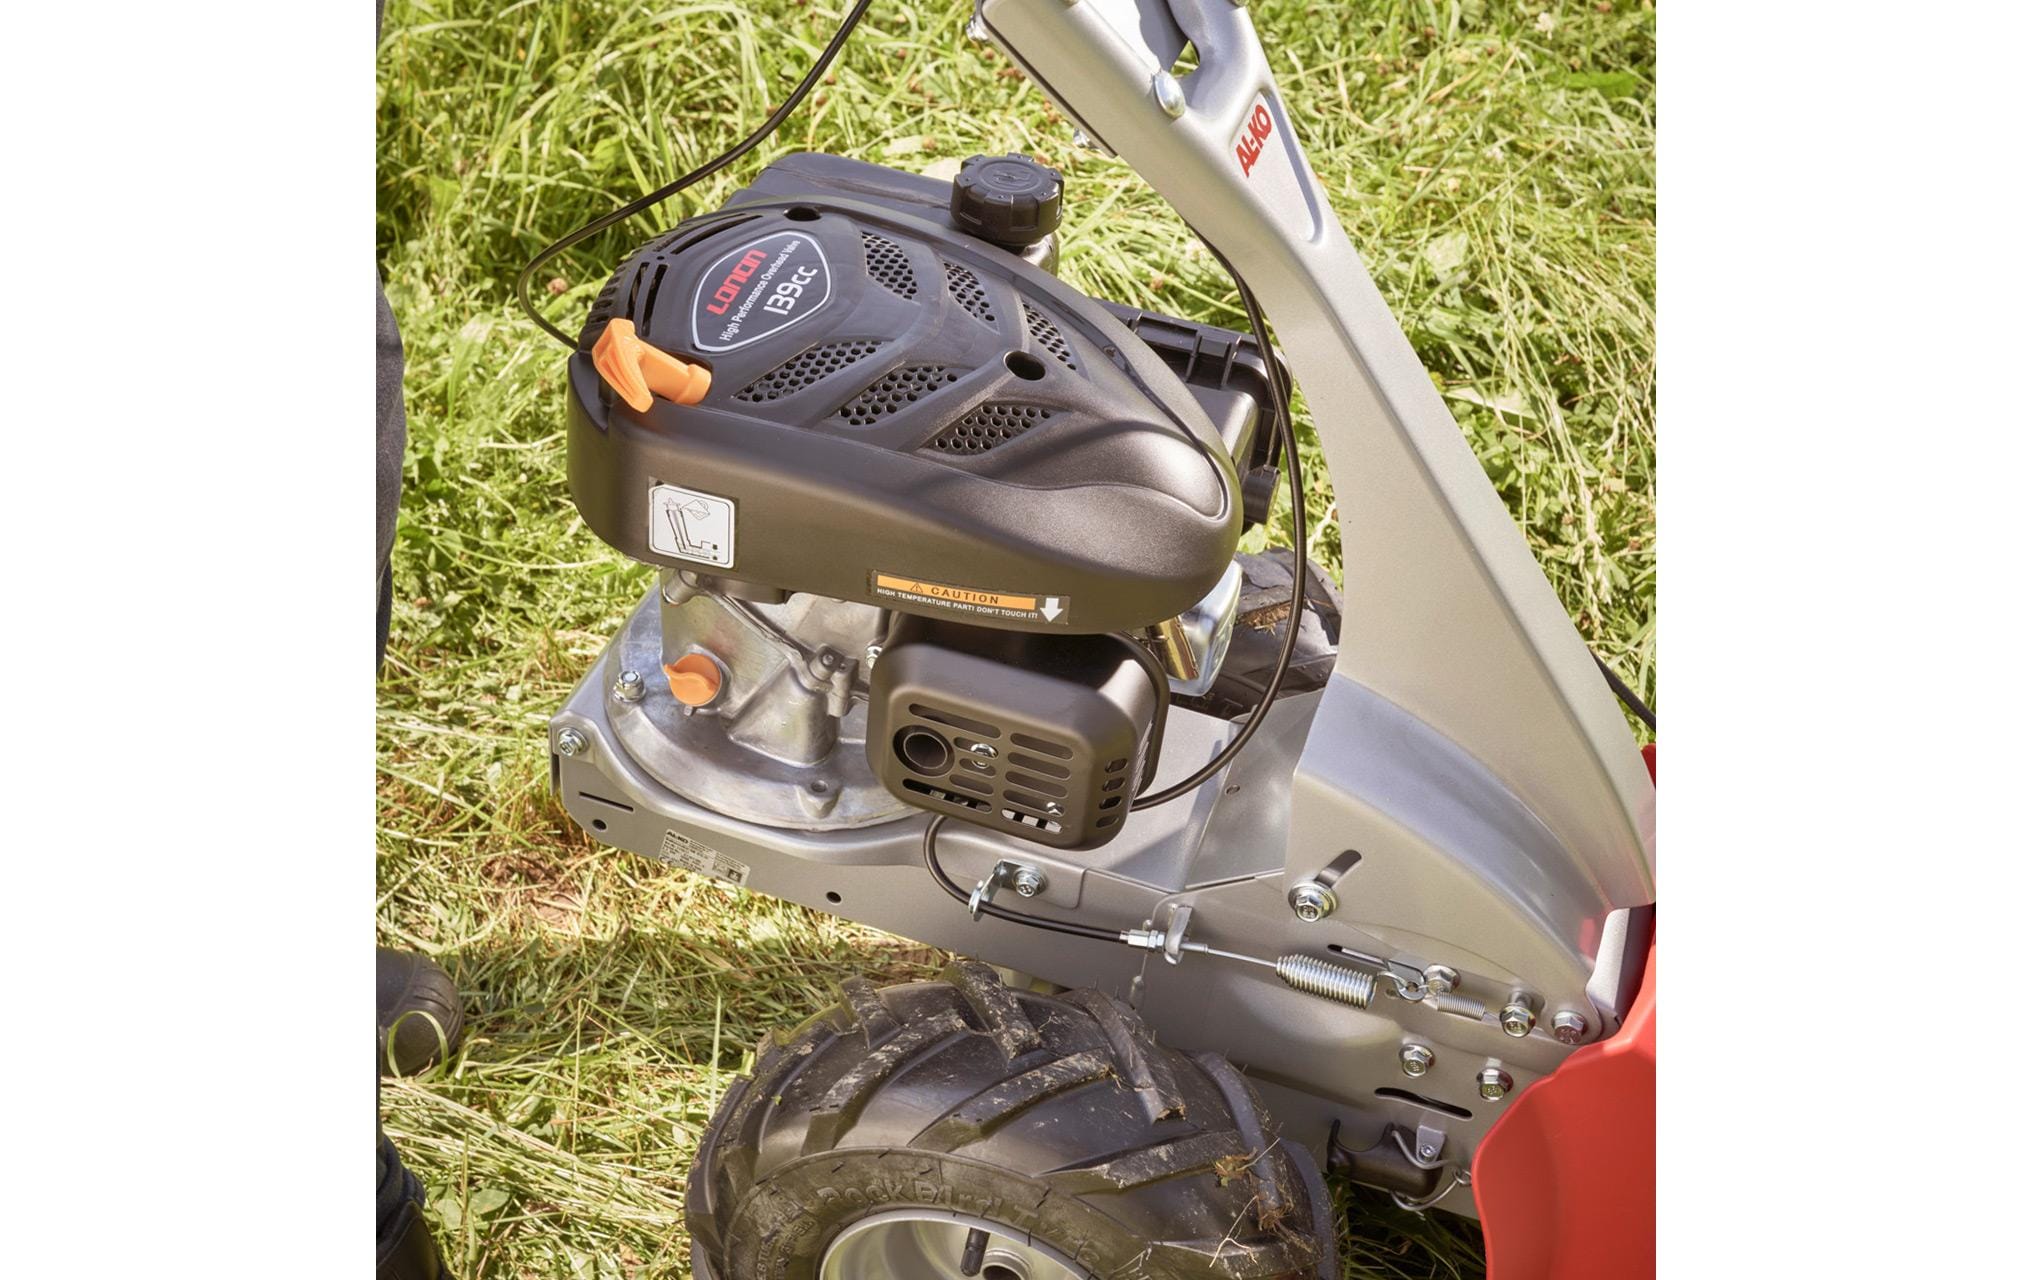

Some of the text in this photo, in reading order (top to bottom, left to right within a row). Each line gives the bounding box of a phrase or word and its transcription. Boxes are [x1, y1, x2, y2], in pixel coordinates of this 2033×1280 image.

[1236, 104, 1272, 178] AL-KO
[719, 322, 740, 341] High
[731, 280, 768, 322] Performance
[761, 252, 789, 280] Overhead
[763, 265, 818, 315] 139cc
[877, 588, 896, 596] HIGH
[898, 592, 951, 608] TEMPERATURE
[976, 606, 1000, 615] DON'T
[1001, 609, 1027, 618] TOUCH
[1028, 611, 1038, 619] IT!
[931, 586, 999, 605] CAUTION
